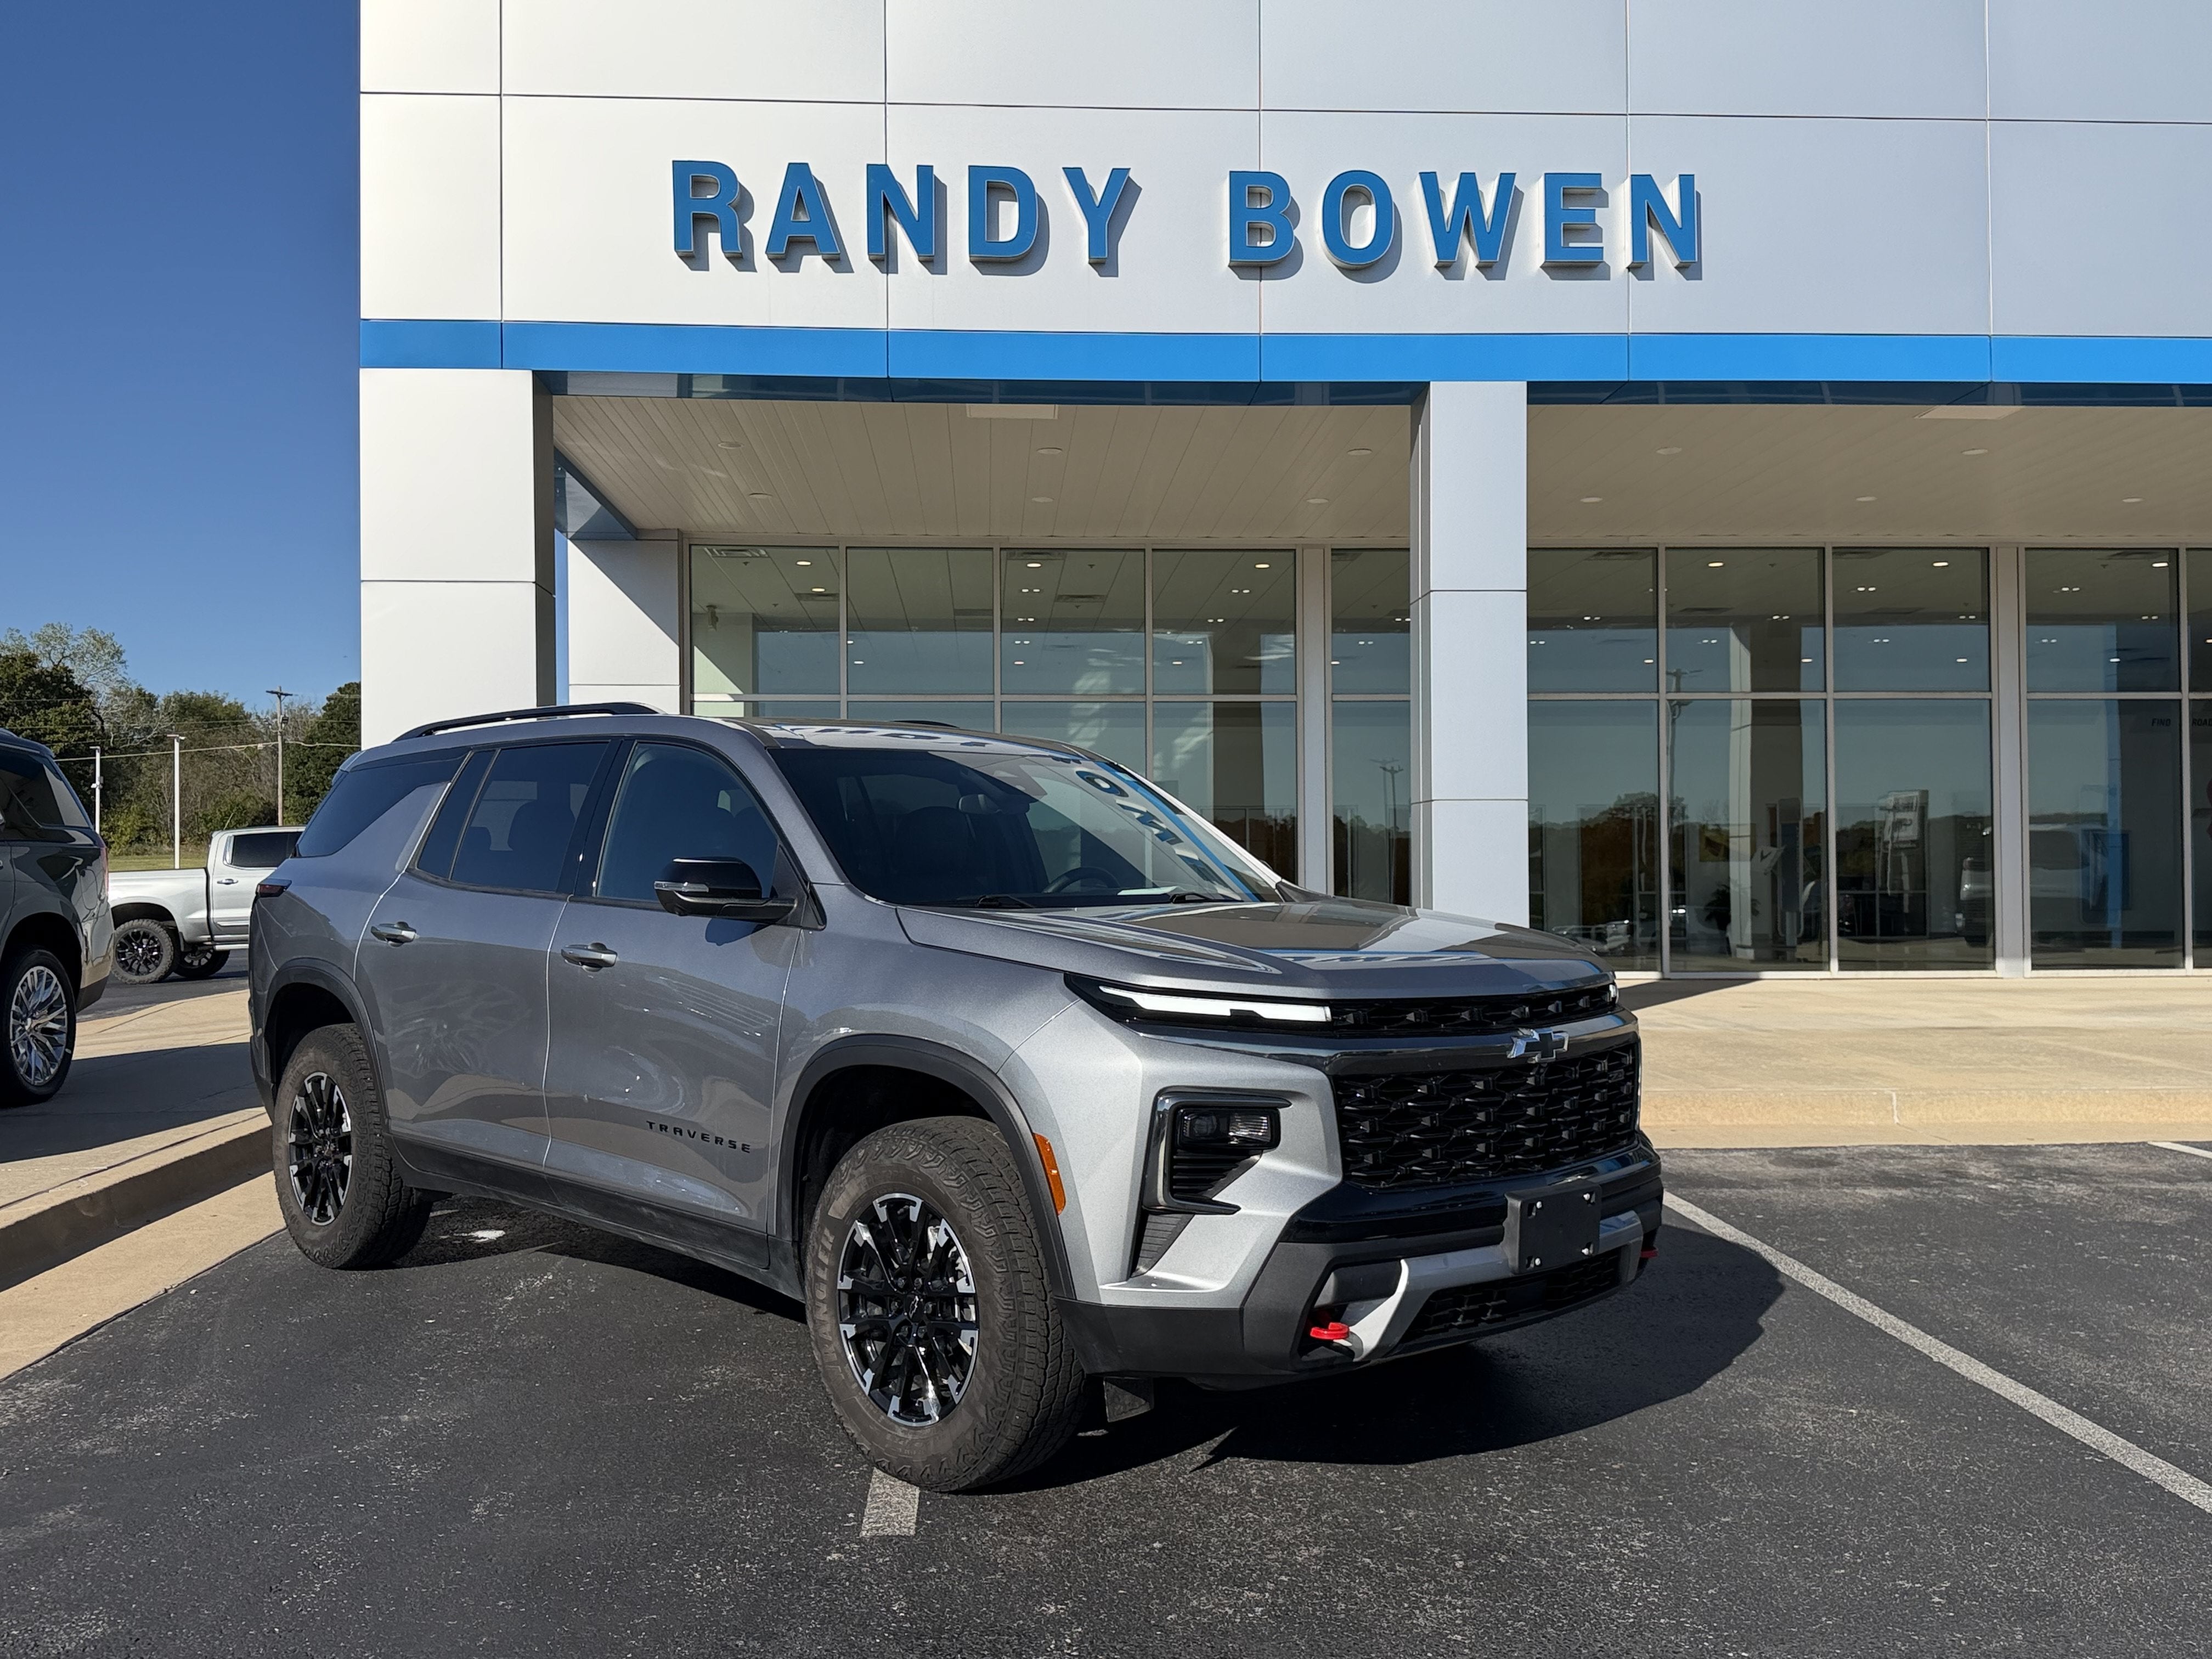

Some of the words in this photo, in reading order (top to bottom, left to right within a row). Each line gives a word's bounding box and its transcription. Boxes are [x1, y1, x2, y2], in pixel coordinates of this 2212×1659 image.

[672, 160, 1131, 264] RANDY
[1228, 170, 1697, 270] BOWEN
[2151, 718, 2171, 727] FIND
[646, 1120, 751, 1154] TRAVERSE
